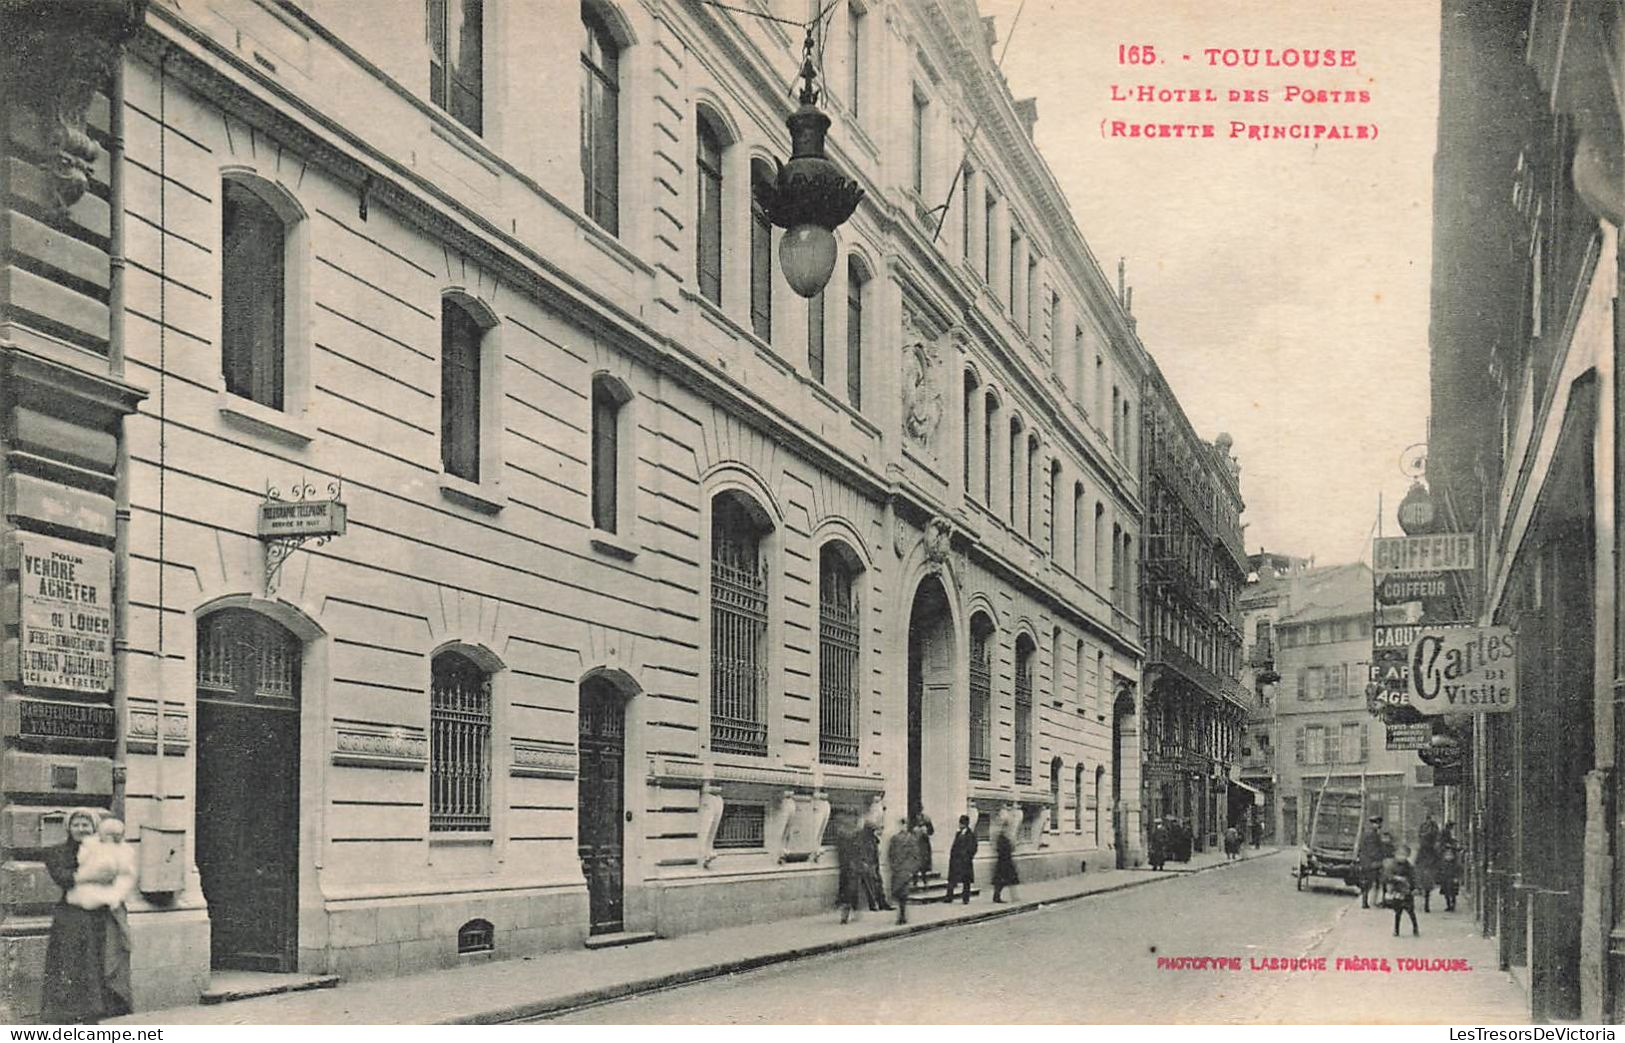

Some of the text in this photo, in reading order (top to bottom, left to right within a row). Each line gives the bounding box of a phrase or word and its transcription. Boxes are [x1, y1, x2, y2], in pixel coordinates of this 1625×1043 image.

[52, 552, 83, 564] POUR
[1376, 538, 1471, 570] COIFFEUR
[25, 555, 75, 581] VENDRE
[40, 578, 97, 604] ACHETER
[1384, 581, 1446, 598] COIFFEUR
[52, 613, 64, 628] OU
[70, 612, 110, 634] LOUER
[1413, 631, 1514, 700] Cartes
[1443, 684, 1511, 705] Visite
